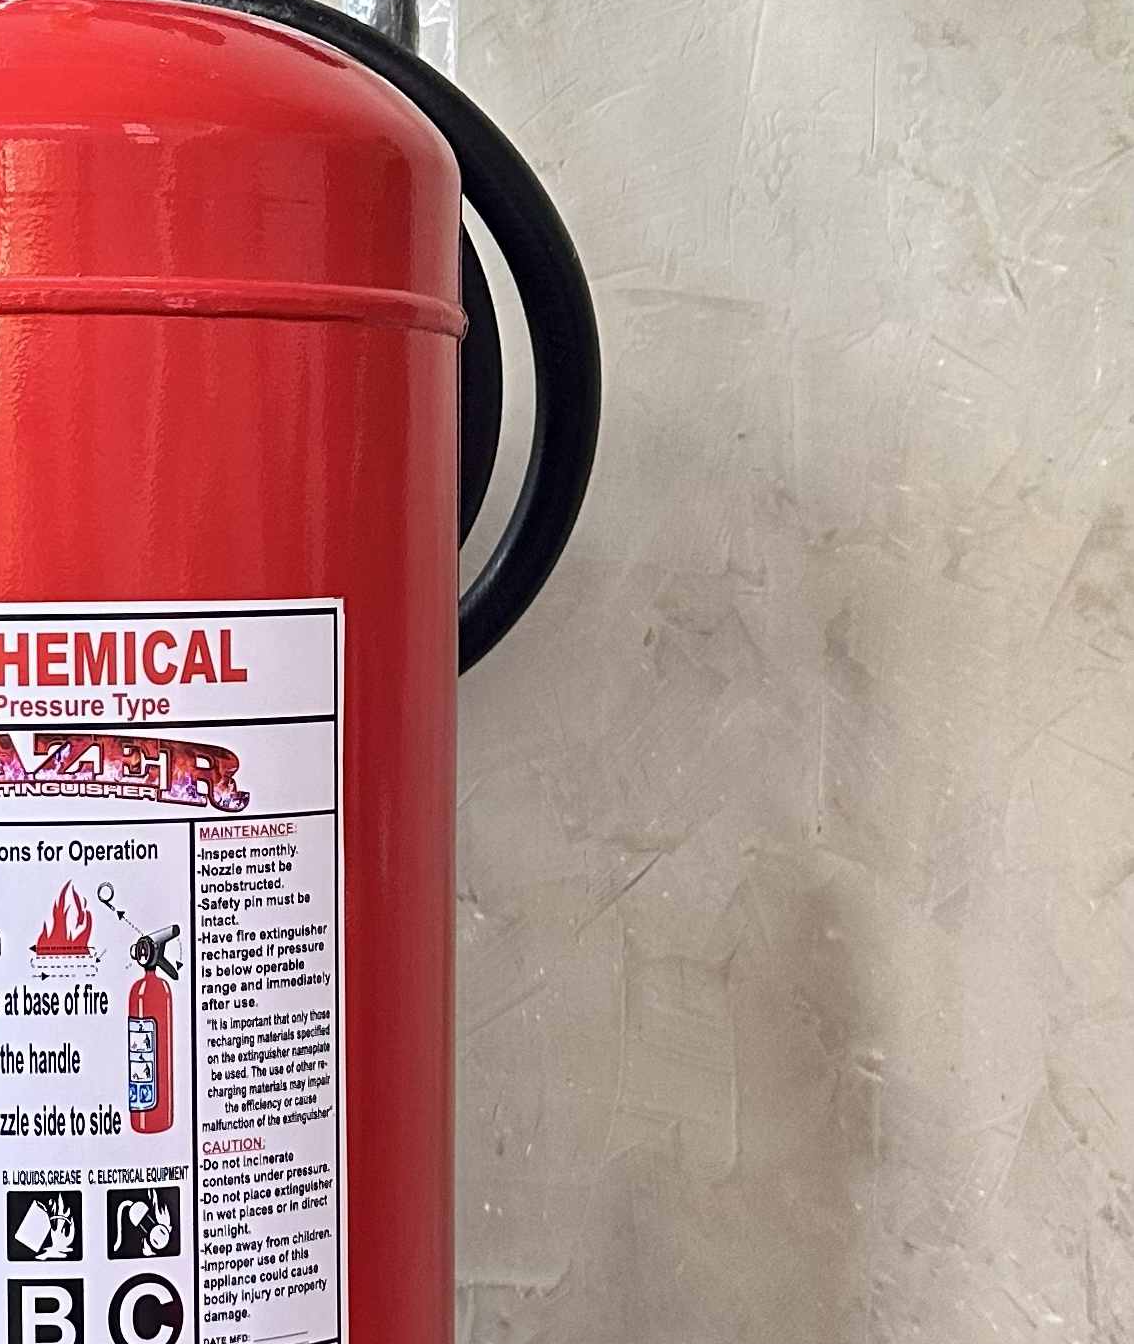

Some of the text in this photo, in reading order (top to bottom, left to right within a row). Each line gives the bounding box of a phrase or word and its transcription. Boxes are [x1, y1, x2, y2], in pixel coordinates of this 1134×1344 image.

[114, 693, 170, 722] Type
[199, 822, 298, 841] MAINTENANCE:
[37, 839, 63, 862] for
[68, 839, 158, 866] Operation
[197, 844, 299, 861] -Inspect monthly.
[246, 860, 292, 874] must be
[201, 877, 284, 893] unobstructed.
[197, 893, 310, 911] -Safety pin must be
[237, 924, 327, 942] fire extinguisher
[201, 941, 324, 961] recharged pressure
[216, 959, 304, 976] below operable
[202, 972, 331, 995] range and immediately
[4, 990, 18, 1015] at
[23, 986, 59, 1015] base
[64, 985, 81, 1015] of
[83, 984, 108, 1015] fire
[202, 998, 230, 1011] after
[208, 1029, 294, 1048] recharging materials
[0, 1044, 24, 1074] the
[29, 1044, 80, 1074] handle
[249, 1080, 287, 1095] materials
[34, 1106, 66, 1135] side
[70, 1105, 85, 1135] to
[90, 1104, 122, 1135] side
[202, 1117, 254, 1132] malfunction
[202, 1137, 266, 1155] CAUTION:
[222, 1151, 293, 1168] not incinerate
[13, 1170, 81, 1186] LIQUIDS,GREASE
[98, 1166, 189, 1184] ELECTRICAL EQUIPMENT
[203, 1170, 284, 1187] contents under
[223, 1178, 333, 1203] not place extinguisher
[217, 1195, 327, 1220] wet places or direct
[203, 1223, 251, 1238] sunlight.
[236, 1235, 289, 1252] away from
[257, 1248, 309, 1266] use of this
[204, 1264, 318, 1290] appliance could cause
[204, 1278, 327, 1306] bodily injury or property
[204, 1308, 250, 1323] damage.
